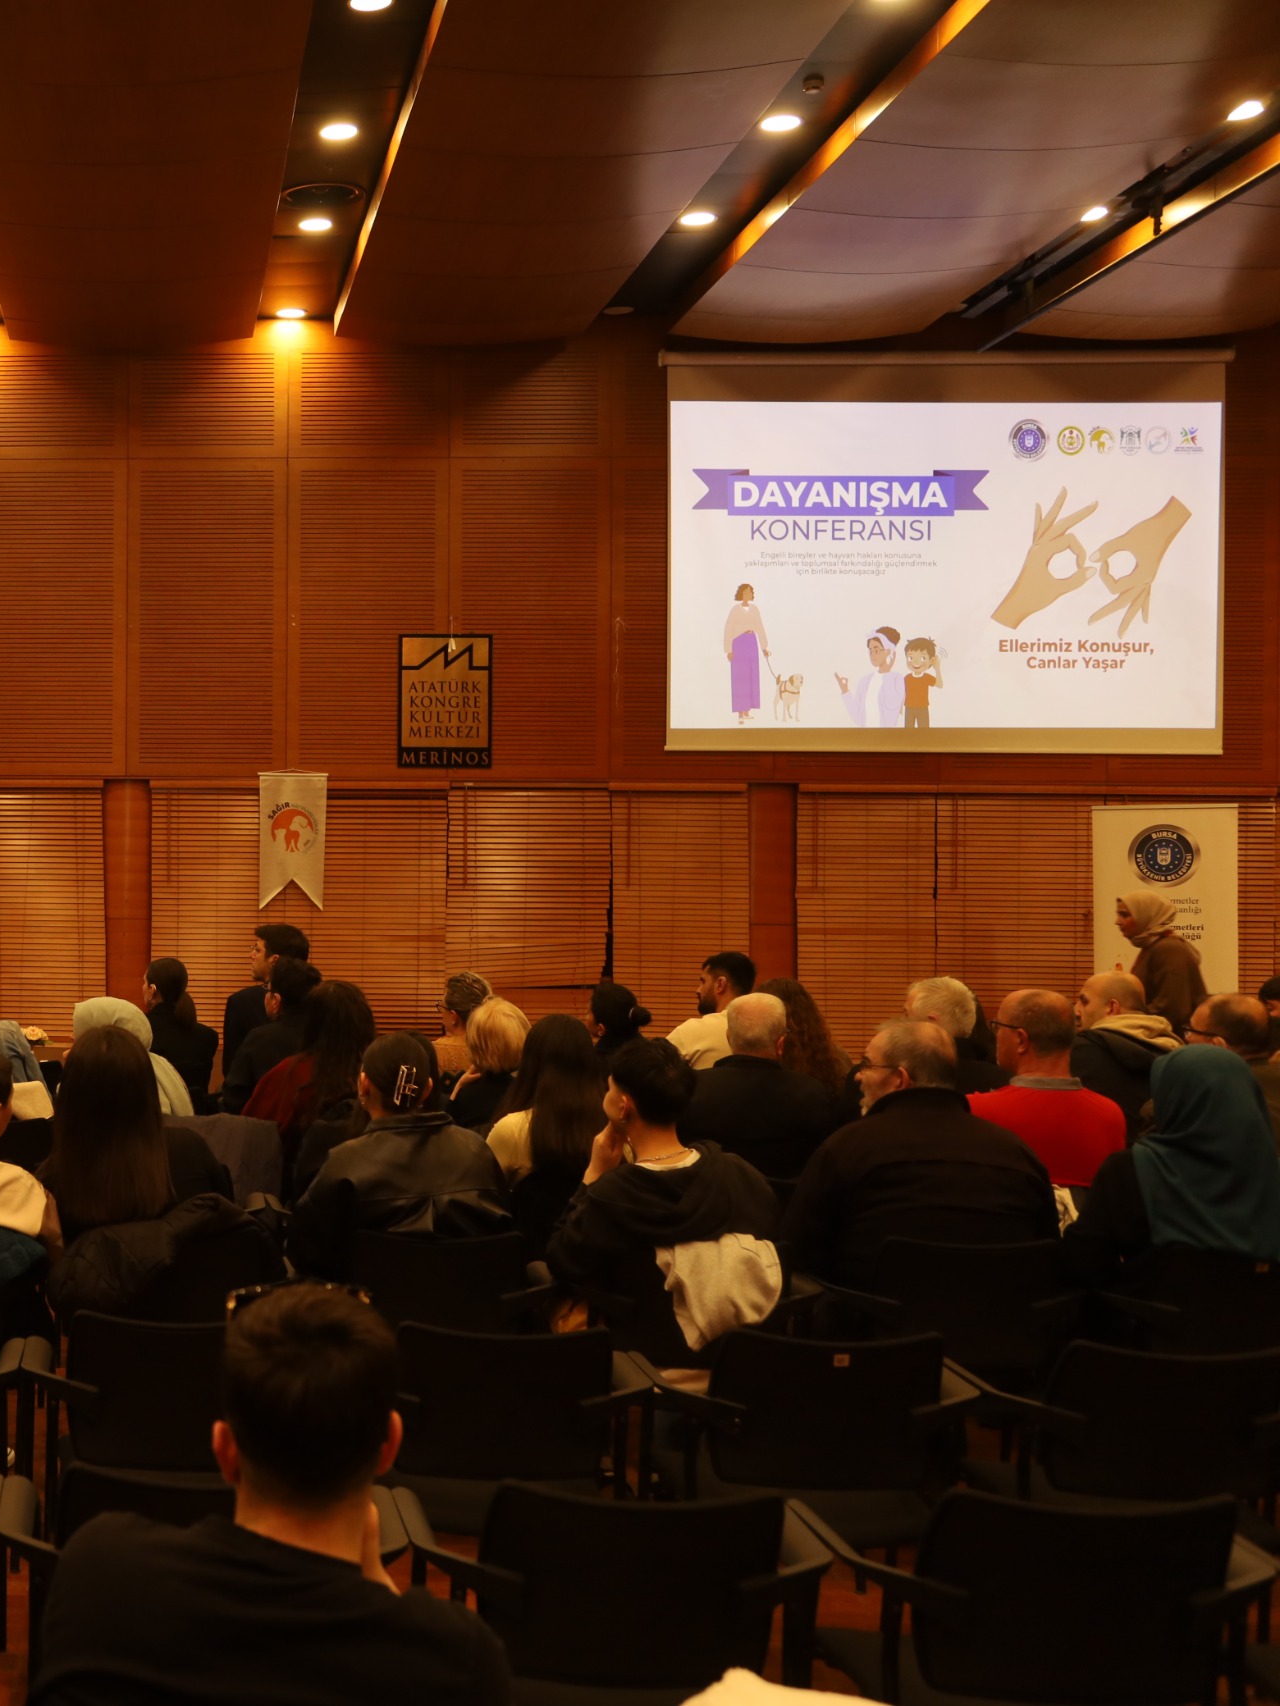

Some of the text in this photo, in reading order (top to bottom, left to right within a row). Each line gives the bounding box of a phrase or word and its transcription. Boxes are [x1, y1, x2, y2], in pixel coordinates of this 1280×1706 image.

[734, 481, 948, 516] DAYANIŞMA
[751, 519, 932, 541] KONFERANSI
[760, 552, 786, 560] Engelli
[788, 552, 816, 560] bireyler
[828, 552, 856, 560] hayvan
[801, 560, 840, 568] toplumsal
[885, 560, 937, 568] güçlendirmek
[796, 568, 810, 576] için
[998, 638, 1154, 656] Ellerimiz Konuşur,
[1026, 656, 1126, 672] Canlar Yaşar
[408, 679, 482, 693] ATATÜRK
[410, 695, 481, 708] KONGRE
[410, 709, 482, 723] KÜLTÜR
[408, 724, 481, 738] MERKEZİ
[401, 749, 489, 765] MERİNOS
[267, 802, 290, 820] SAĞIR
[1151, 831, 1177, 839] BURSA
